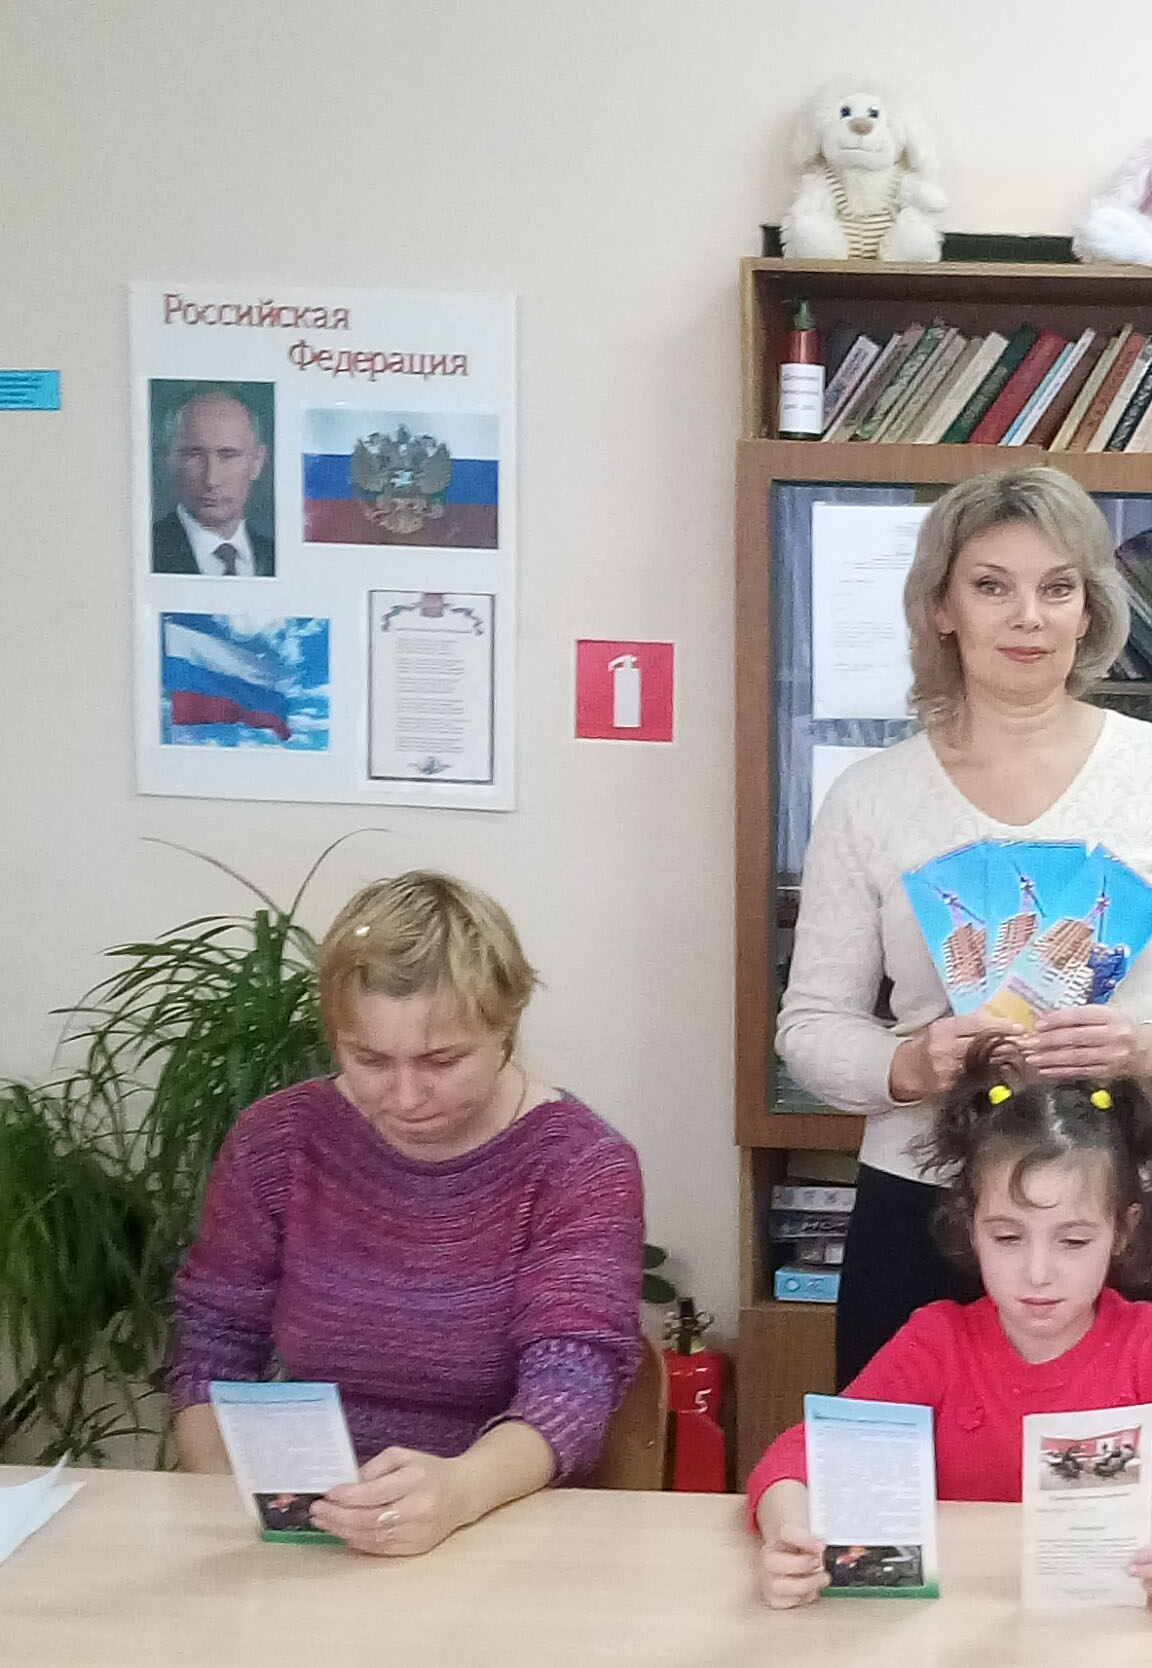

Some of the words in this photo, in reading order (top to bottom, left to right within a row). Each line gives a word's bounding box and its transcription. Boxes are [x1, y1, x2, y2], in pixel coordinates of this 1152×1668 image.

[163, 293, 351, 330] Российская
[288, 339, 469, 382] Федерация
[694, 1388, 712, 1414] 5
